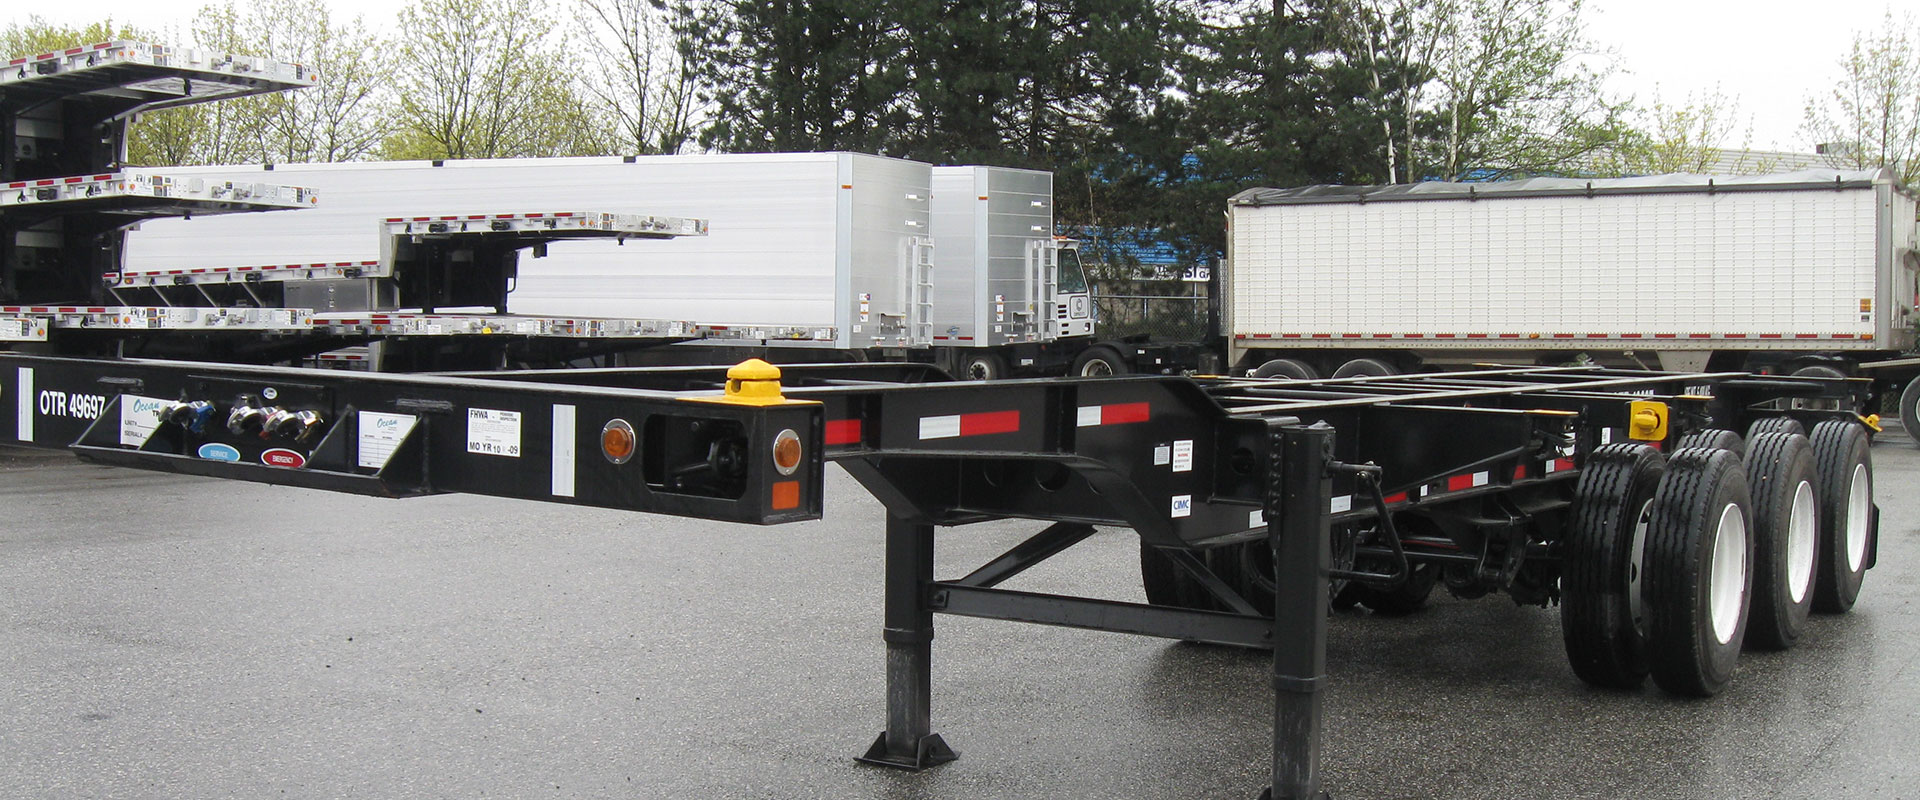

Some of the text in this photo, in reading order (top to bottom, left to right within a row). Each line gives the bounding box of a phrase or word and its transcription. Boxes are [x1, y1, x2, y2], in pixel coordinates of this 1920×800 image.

[40, 390, 105, 420] OTR 49697
[133, 398, 160, 413] Ocean
[469, 409, 489, 419] FHWA
[469, 441, 480, 451] MO
[482, 442, 492, 452] YR
[1173, 499, 1189, 510] CIMC
